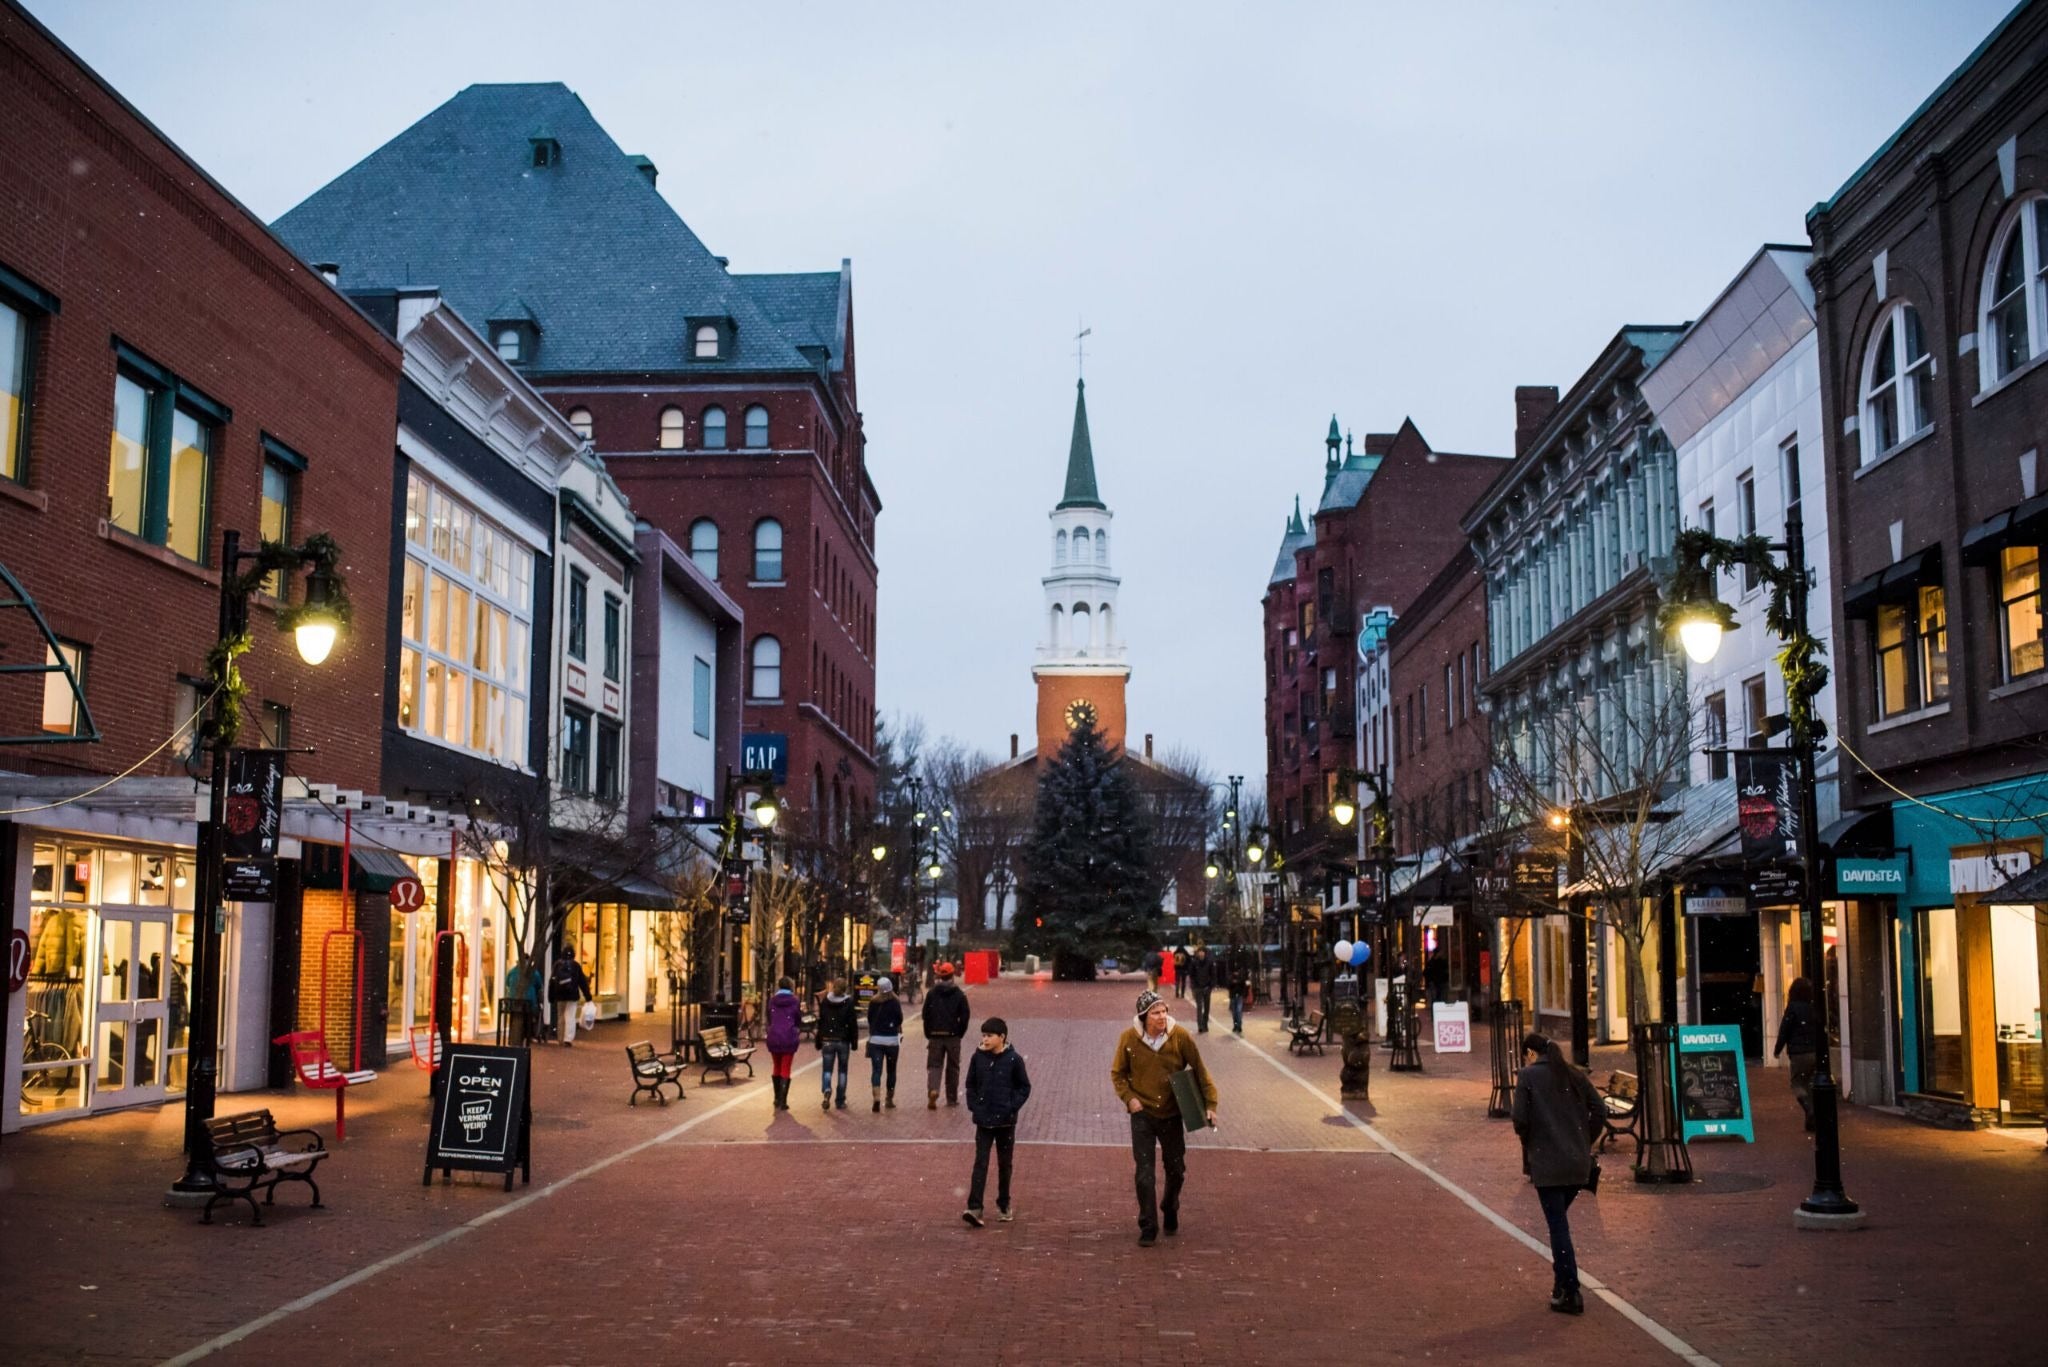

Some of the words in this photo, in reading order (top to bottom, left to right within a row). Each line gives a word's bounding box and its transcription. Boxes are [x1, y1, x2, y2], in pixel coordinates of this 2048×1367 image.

[746, 746, 777, 770] GAP
[1842, 869, 1902, 882] DAVIDsTEA
[1439, 1023, 1465, 1036] 50%
[1439, 1034, 1465, 1045] OFF
[459, 1075, 502, 1088] OPEN
[1682, 1071, 1704, 1097] 2
[466, 1106, 485, 1115] KEEP
[459, 1113, 492, 1123] VERMONT
[463, 1121, 487, 1130] WEIRD
